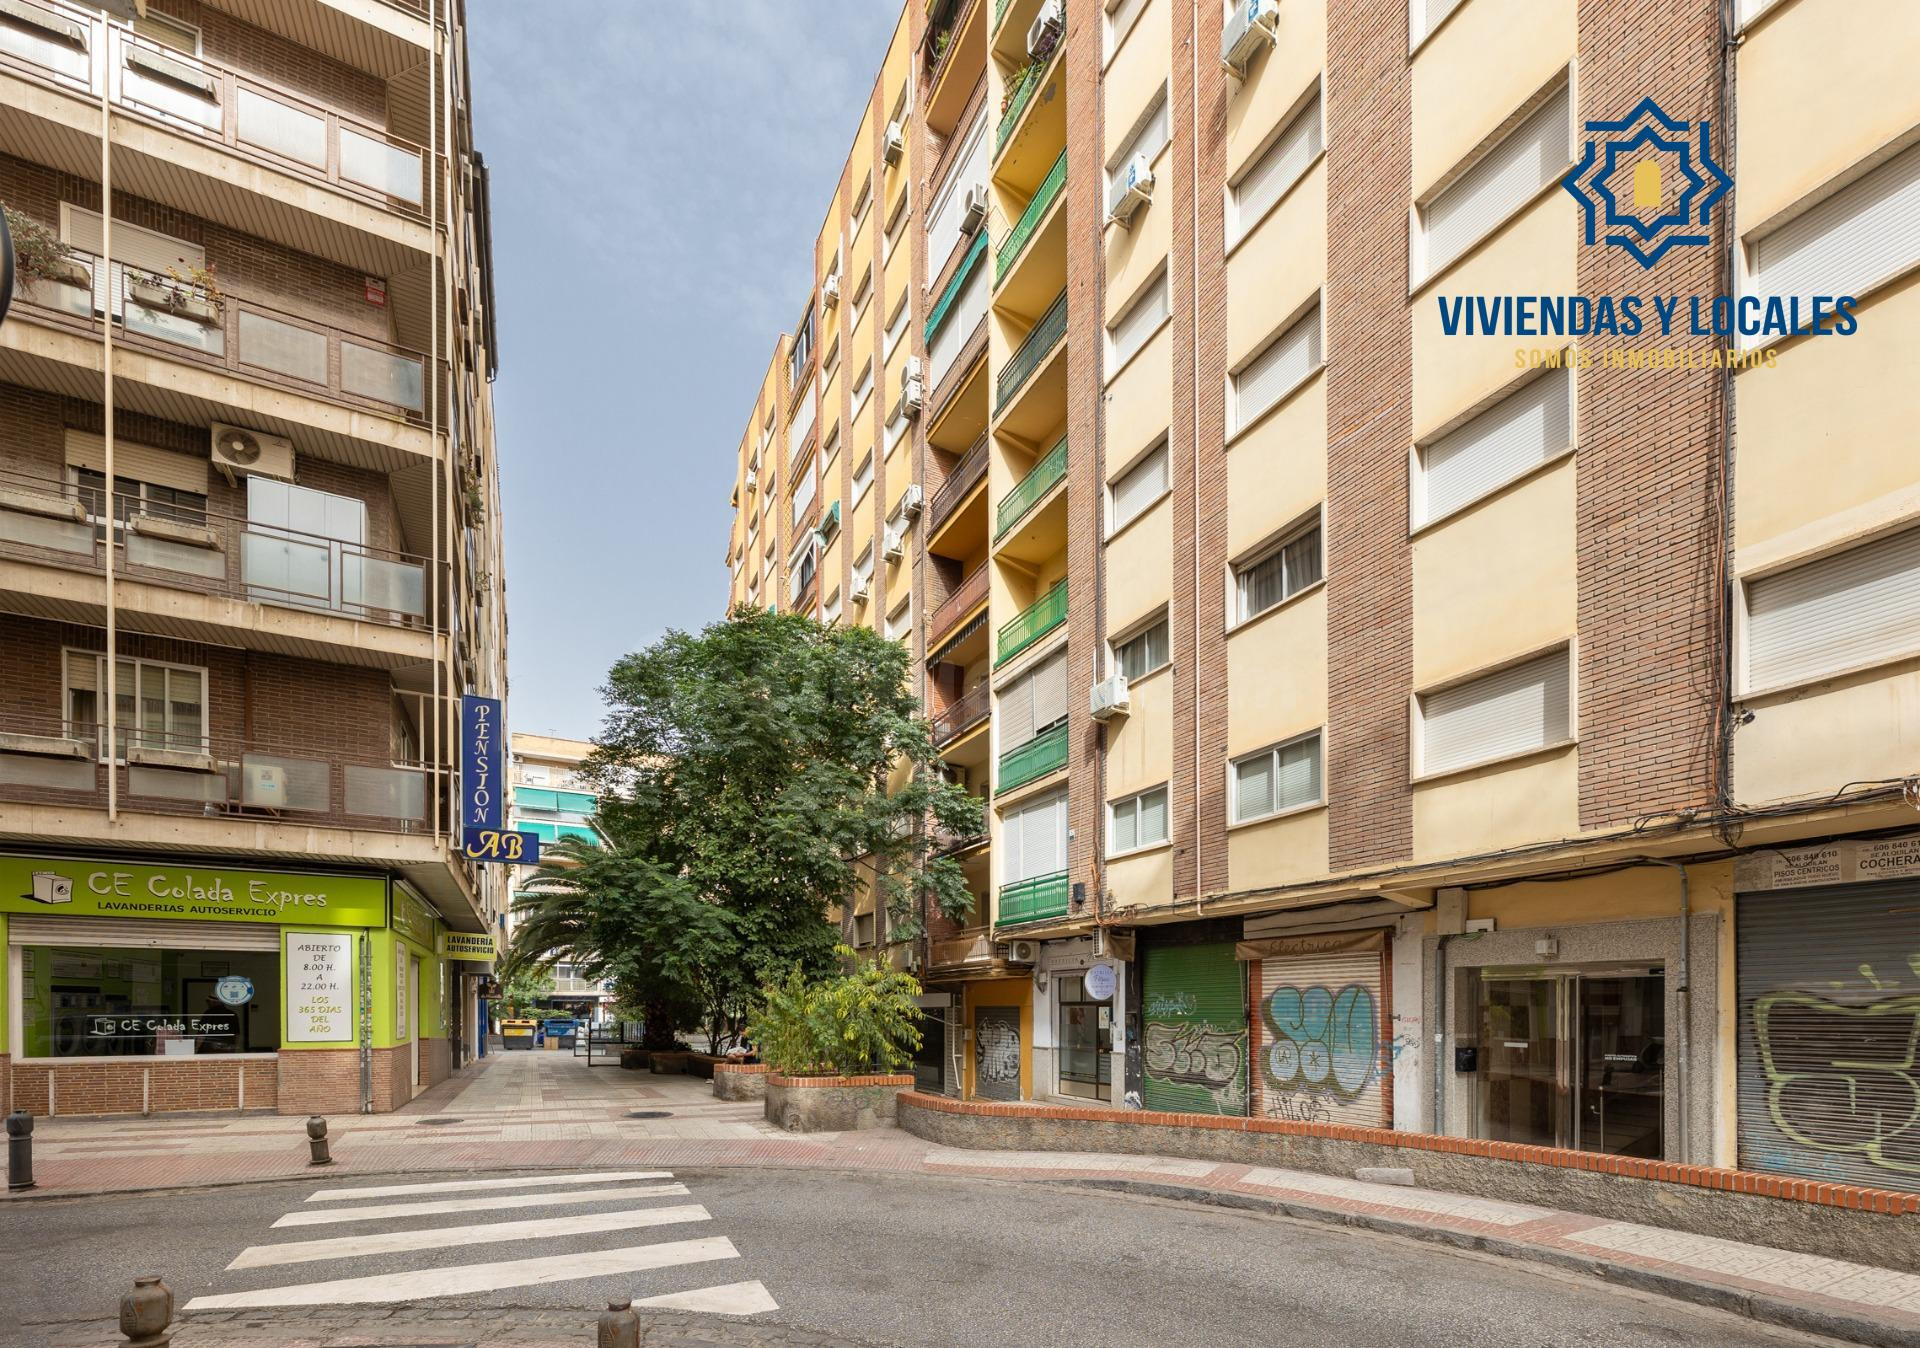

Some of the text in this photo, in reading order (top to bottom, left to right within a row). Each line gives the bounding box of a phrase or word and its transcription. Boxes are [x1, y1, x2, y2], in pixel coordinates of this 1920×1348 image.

[466, 831, 524, 860] AB
[88, 872, 327, 912] CE Colada Expres
[97, 901, 276, 916] LAVANDERIAS AUTOSERVICIO
[297, 944, 341, 952] ABIERTO
[313, 954, 326, 962] DE
[299, 1006, 316, 1014] 365
[121, 1018, 230, 1034] CE Colada Expres
